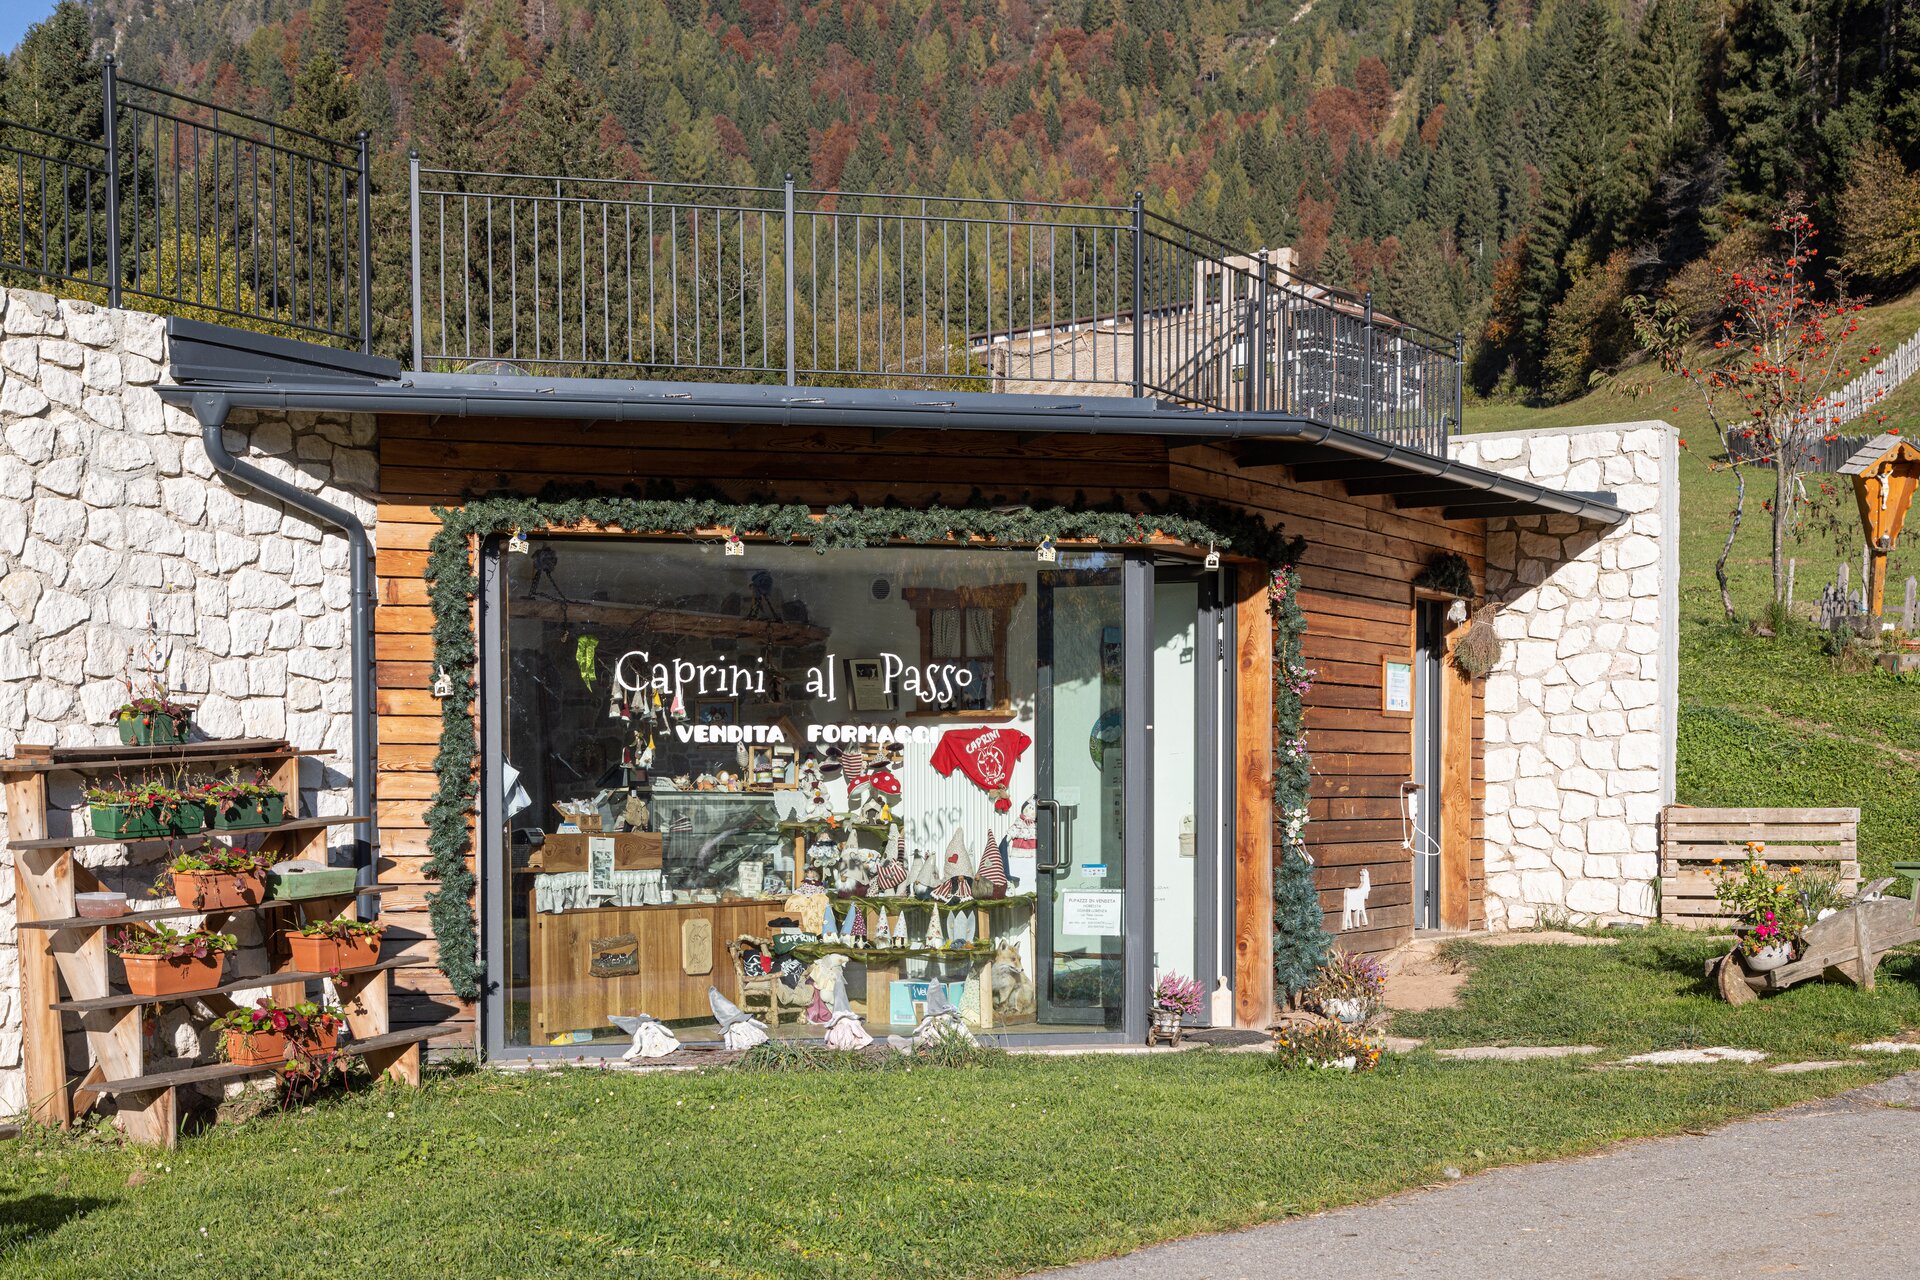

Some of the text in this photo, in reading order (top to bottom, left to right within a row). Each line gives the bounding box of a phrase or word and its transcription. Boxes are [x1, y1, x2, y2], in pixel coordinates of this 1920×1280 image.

[616, 651, 972, 710] Caprini al Passo
[675, 725, 938, 743] VENDITA FORMAGGI
[965, 729, 1000, 754] CAPRINI
[780, 933, 818, 944] CAPRINI
